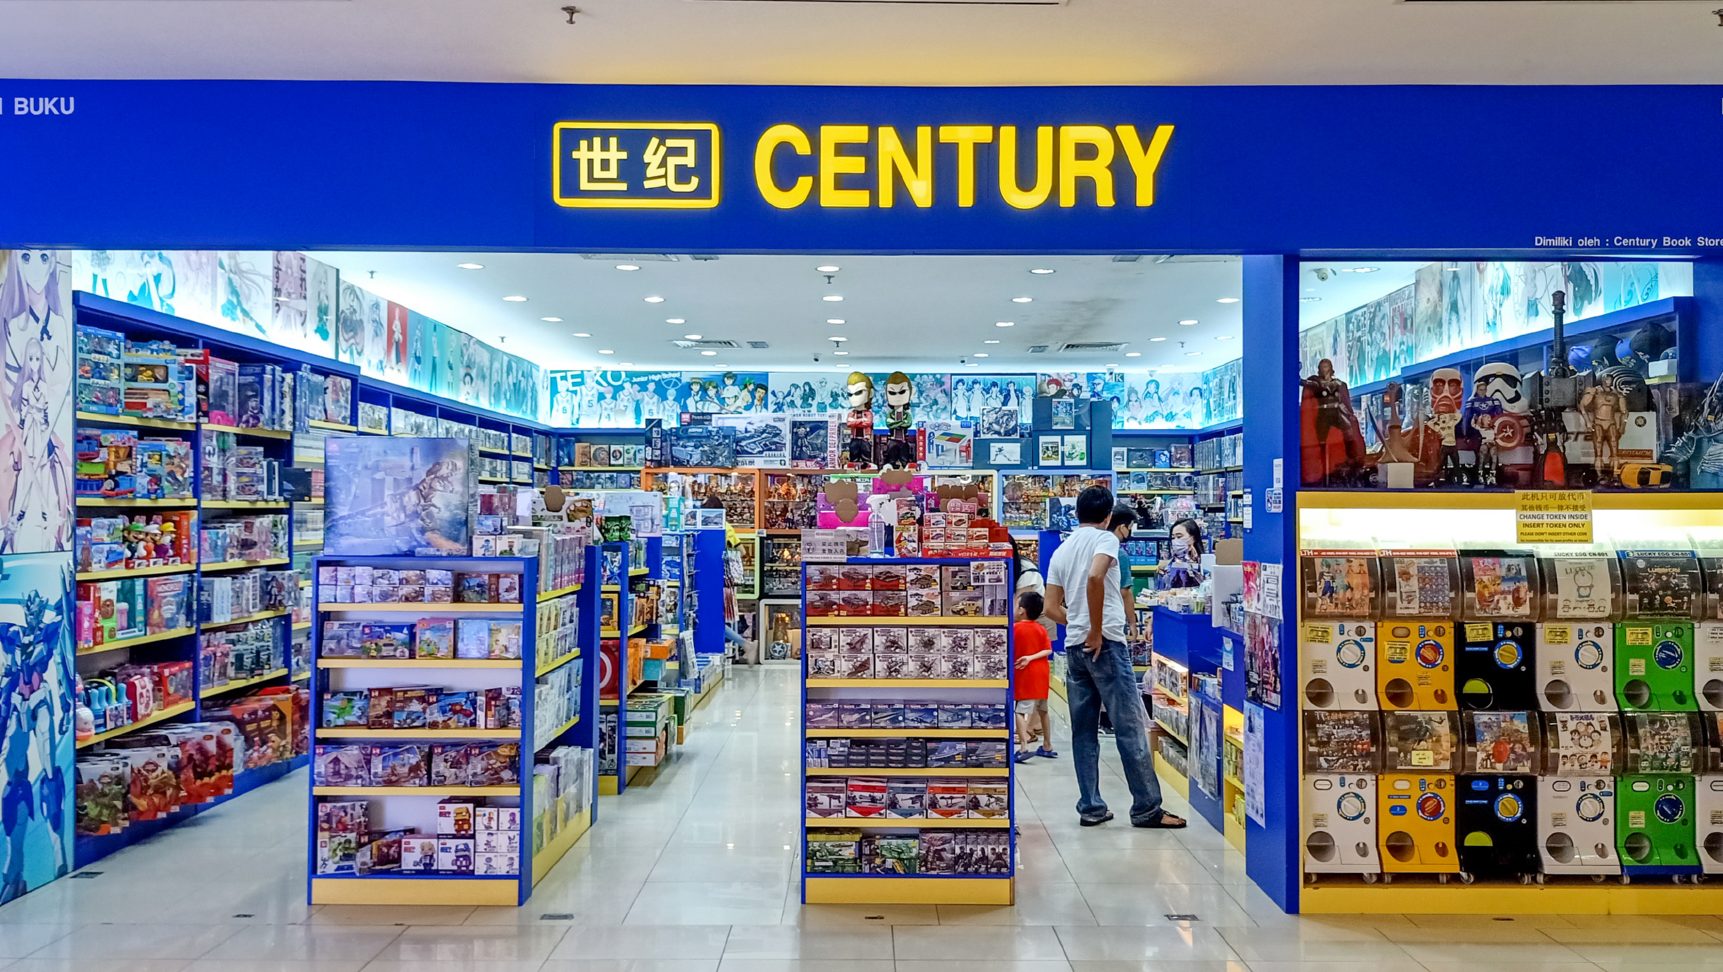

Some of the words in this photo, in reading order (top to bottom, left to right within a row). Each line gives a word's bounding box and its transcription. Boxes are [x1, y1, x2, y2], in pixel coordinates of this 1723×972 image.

[14, 96, 75, 116] BUKU
[572, 136, 699, 193] 世纪
[754, 123, 1176, 209] CENTURY
[1534, 236, 1573, 247] Dimiliki
[1577, 236, 1600, 247] oleh
[1613, 236, 1658, 249] Century
[1662, 236, 1692, 247] Book
